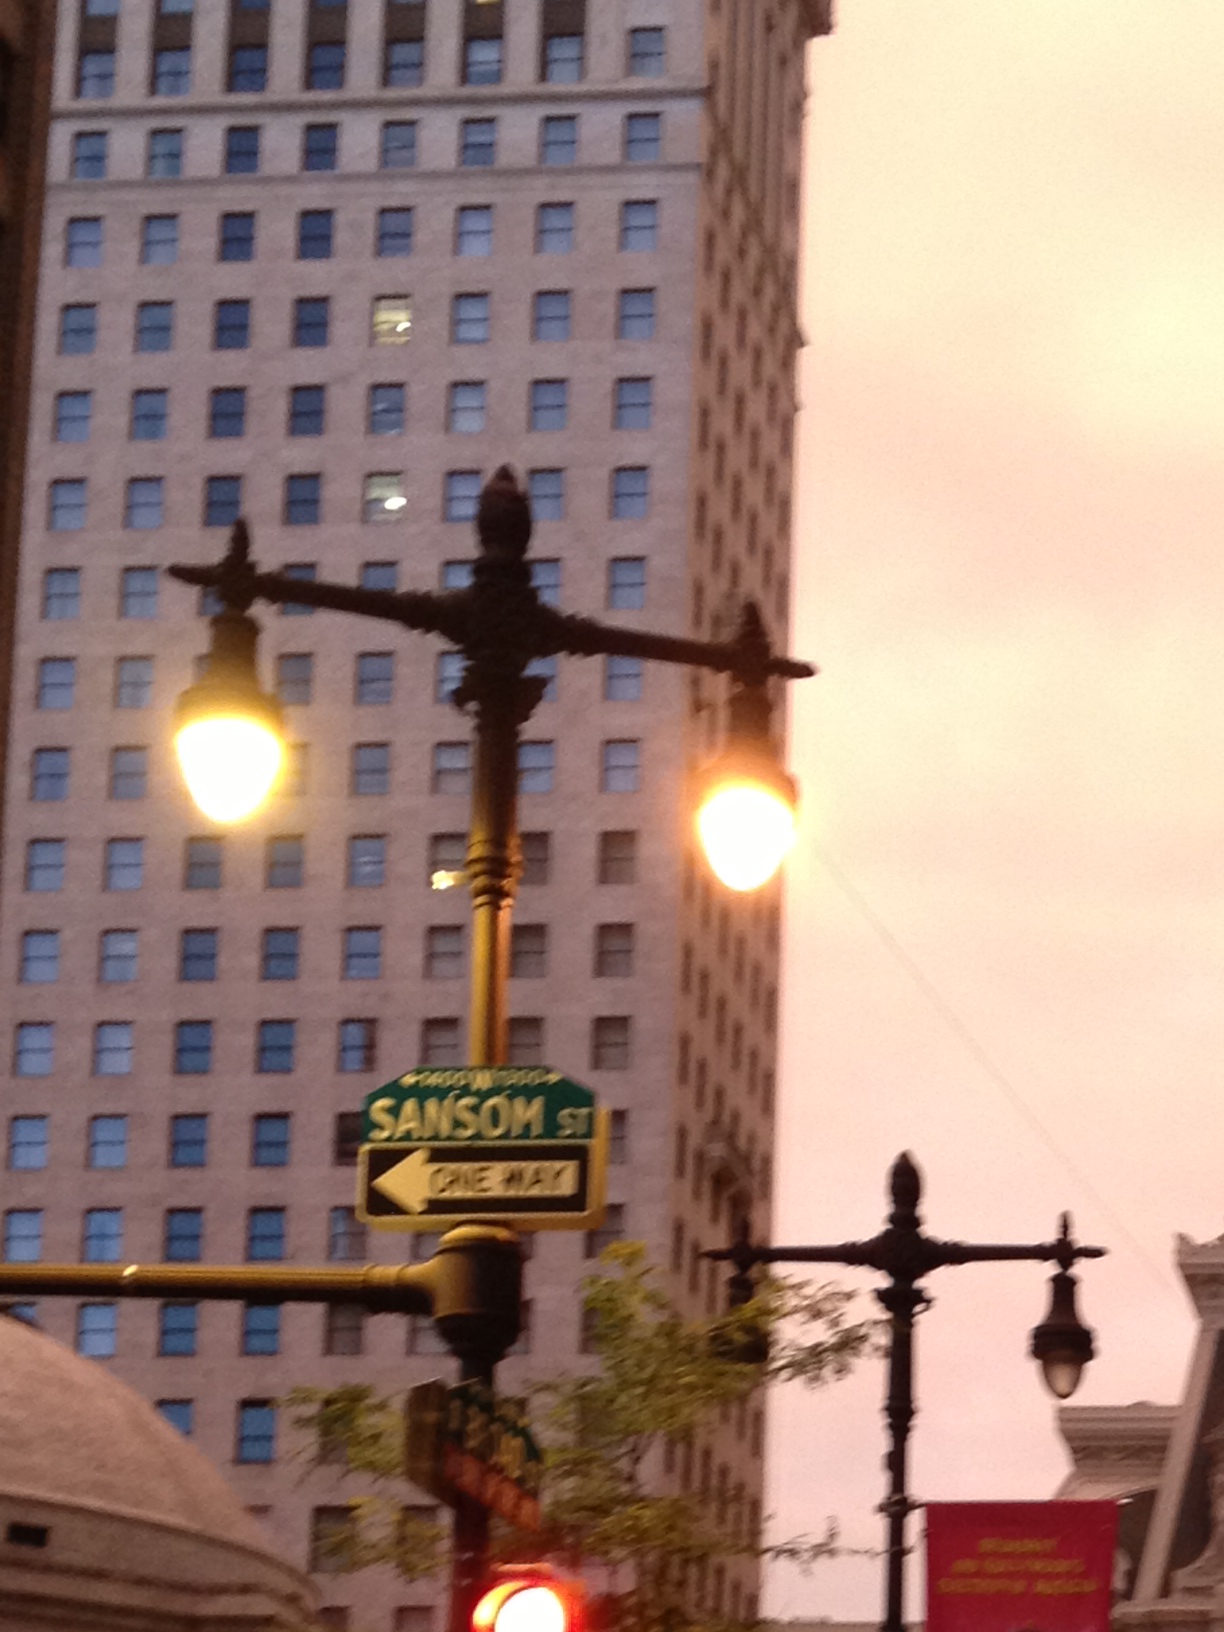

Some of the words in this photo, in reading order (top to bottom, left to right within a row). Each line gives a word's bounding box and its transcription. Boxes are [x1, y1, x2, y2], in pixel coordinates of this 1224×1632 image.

[368, 1094, 546, 1142] SANSOM
[556, 1106, 594, 1138] ST
[430, 1165, 493, 1195] ONE
[501, 1164, 569, 1192] WAY
